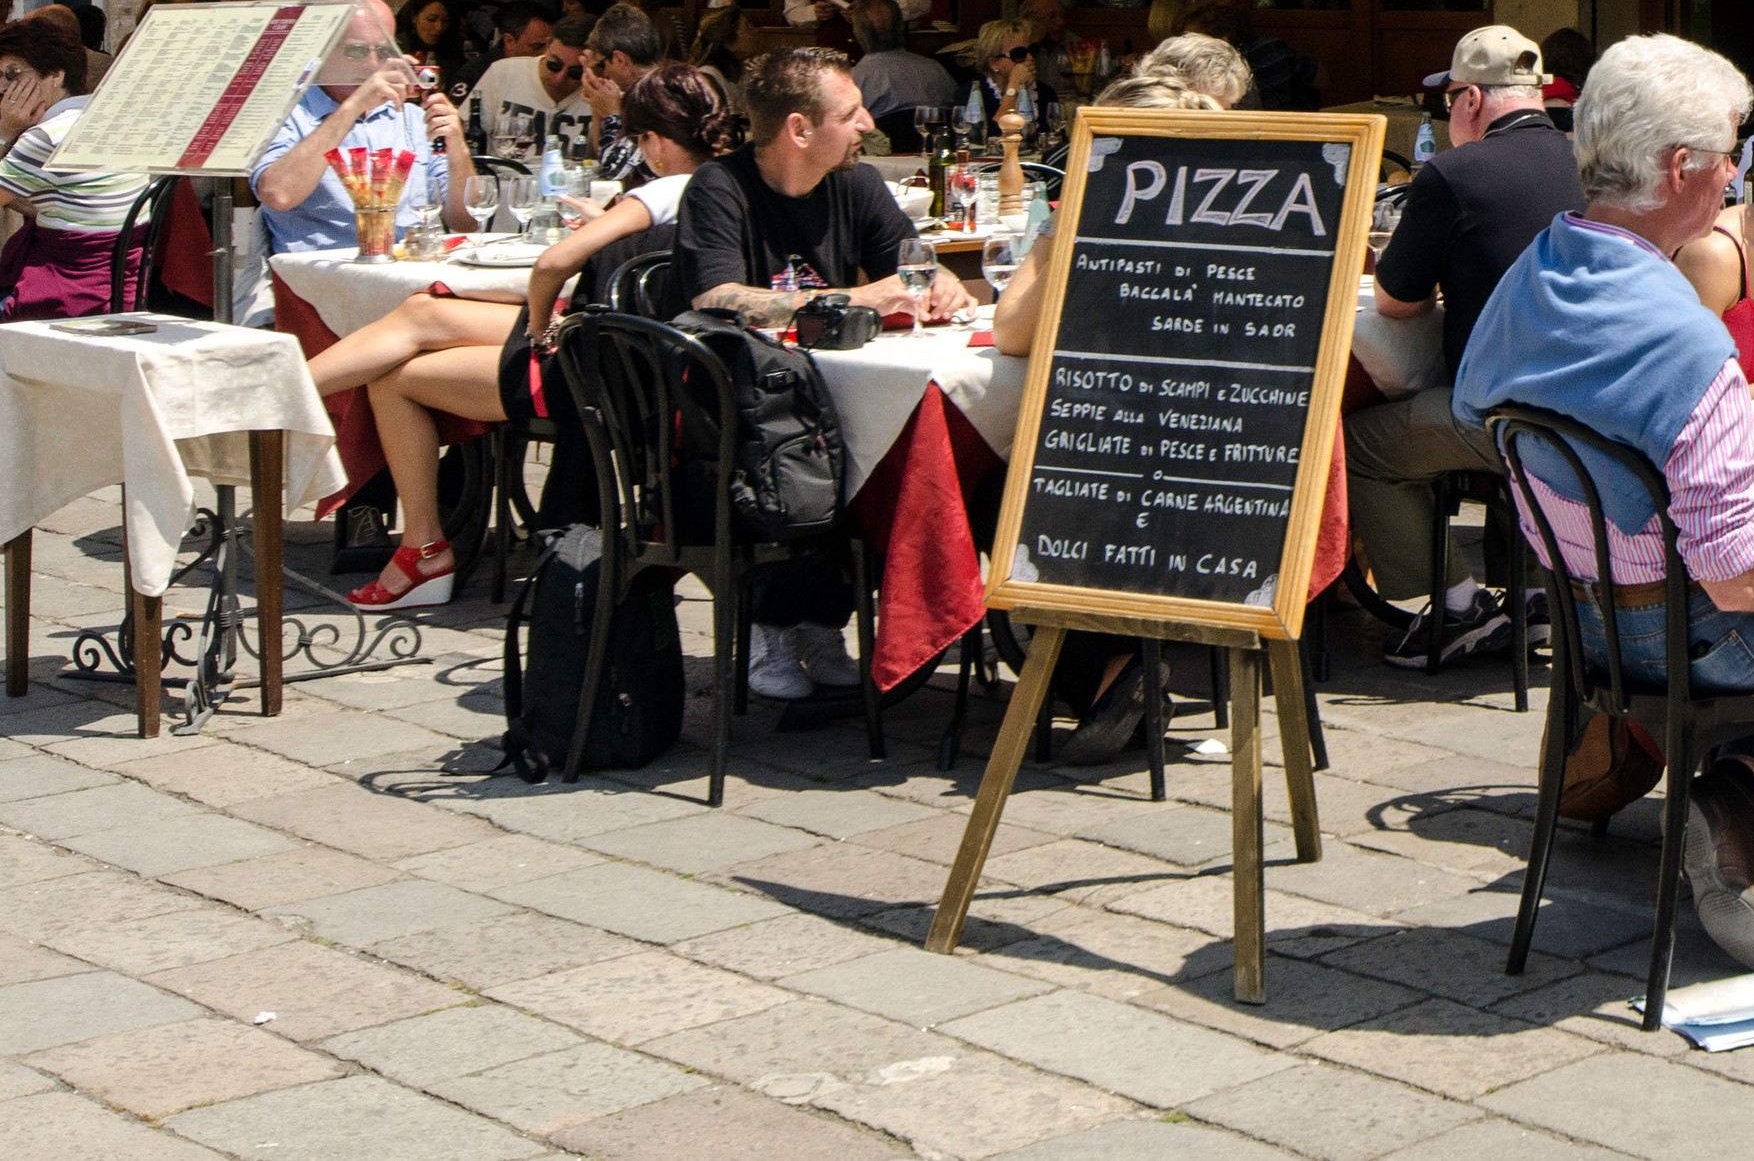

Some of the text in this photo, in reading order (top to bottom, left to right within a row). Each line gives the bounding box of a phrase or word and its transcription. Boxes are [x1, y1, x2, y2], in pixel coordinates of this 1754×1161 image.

[1114, 159, 1327, 236] PIZZA
[1076, 253, 1161, 274] ANTIPASTI
[1207, 263, 1256, 281] PESCE
[1213, 291, 1305, 308] MANTECATO
[1151, 315, 1296, 338] SARDE IN SAOR
[1055, 366, 1133, 392] RISOTTO
[1158, 378, 1210, 398] SCAMPI
[1229, 383, 1309, 407] ZUCCHINE
[1050, 398, 1243, 433] SEPPIE ALLA VENEZIANA
[1044, 429, 1131, 455] GRIGLIATE
[1160, 439, 1205, 460] PESCE
[1224, 443, 1300, 464] FRITTURE
[1033, 477, 1109, 500] TAGLIATE
[1141, 489, 1199, 511] CARNE
[1203, 493, 1290, 518] ARGENTINA
[1037, 534, 1257, 579] DOLCI FATTI IN CASA
